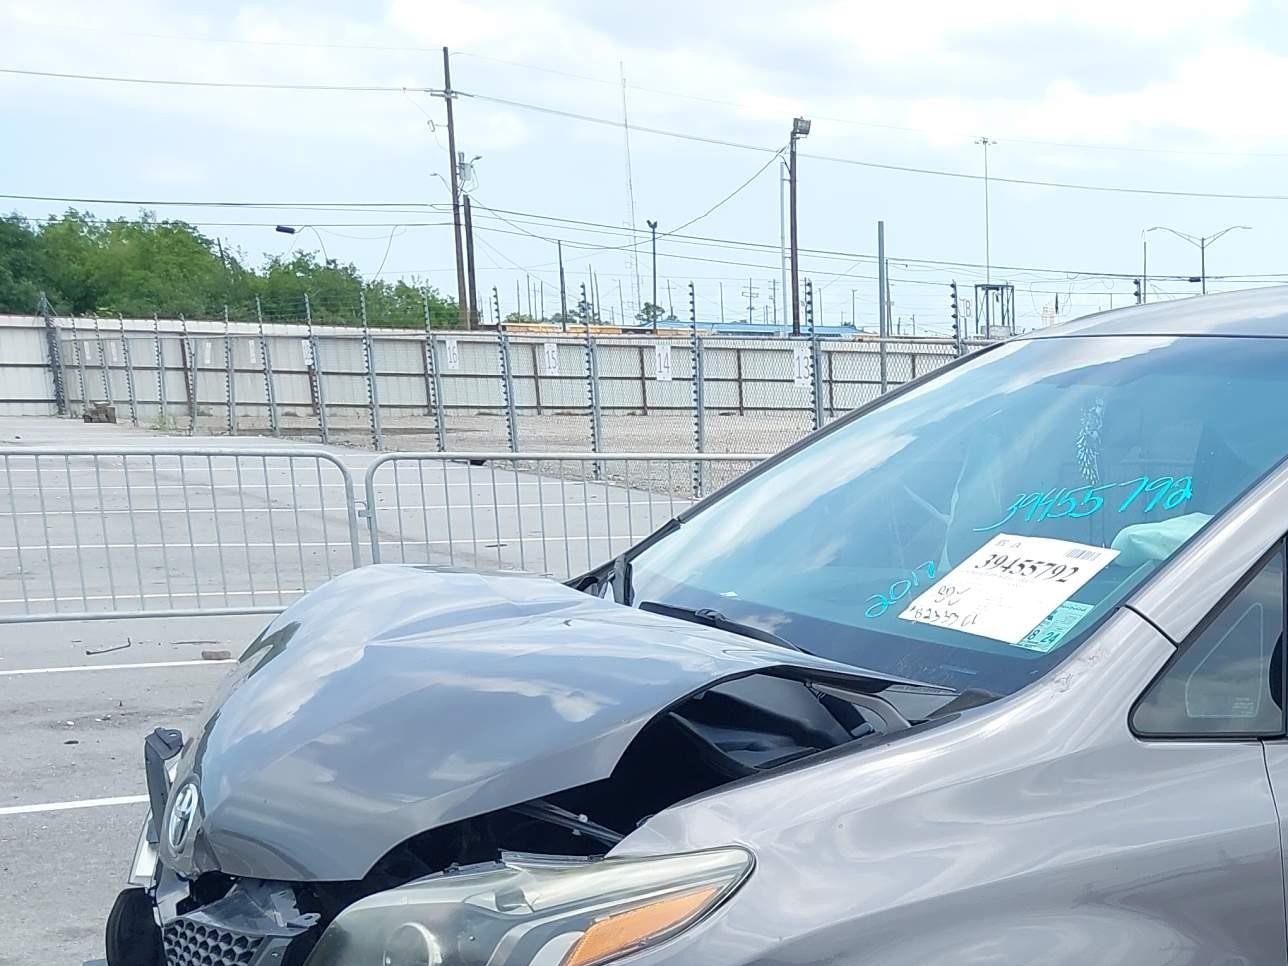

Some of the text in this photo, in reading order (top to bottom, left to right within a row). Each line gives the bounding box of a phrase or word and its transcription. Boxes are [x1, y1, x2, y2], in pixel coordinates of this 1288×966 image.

[546, 349, 558, 369] 15
[657, 352, 671, 374] 14
[796, 355, 810, 380] 13
[972, 474, 1193, 533] 39455792
[973, 552, 1080, 583] 39455792
[863, 559, 935, 619] 2017
[1027, 629, 1061, 644] 8 24
